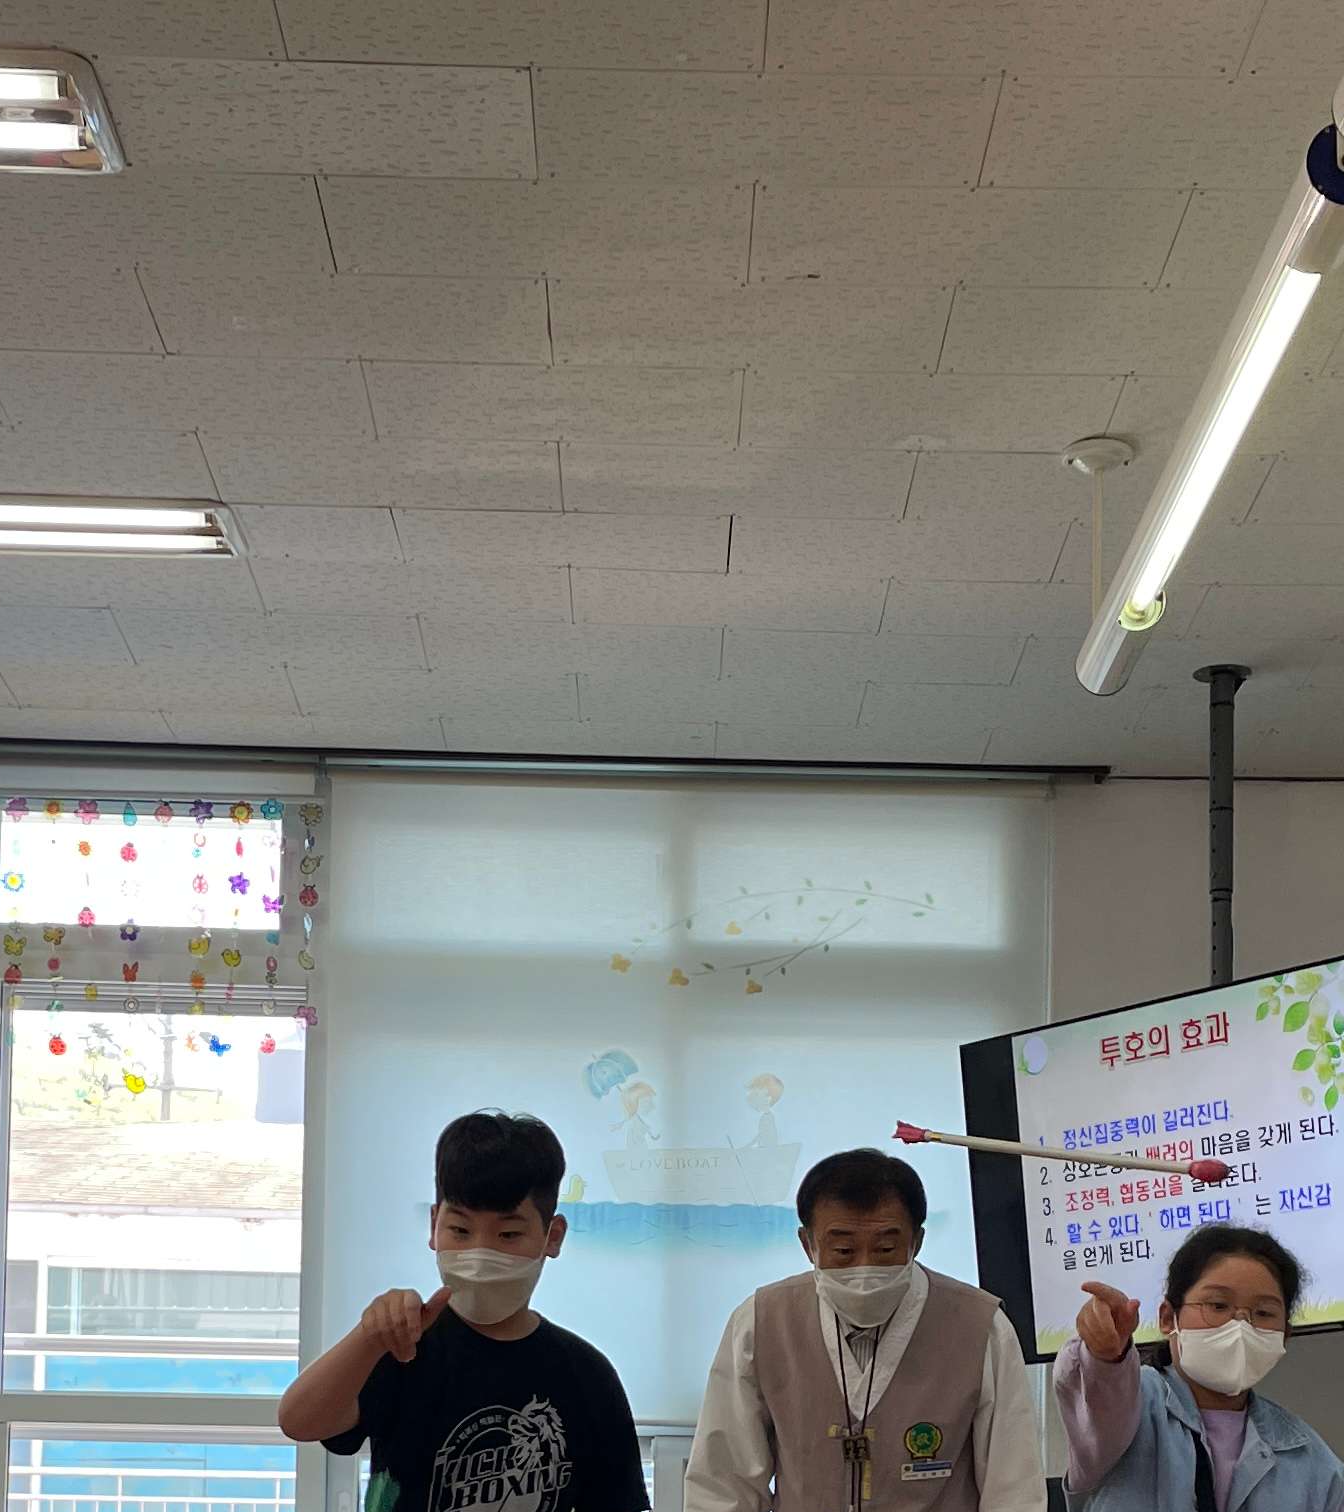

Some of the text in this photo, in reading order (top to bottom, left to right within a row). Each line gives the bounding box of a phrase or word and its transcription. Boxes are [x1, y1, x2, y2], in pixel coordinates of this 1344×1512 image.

[1100, 1011, 1230, 1069] 투호의 효과
[1062, 1114, 1157, 1151] 정신집중력이
[1163, 1099, 1234, 1133] 길러진다.
[1200, 1129, 1251, 1157] 마음을
[1257, 1121, 1293, 1148] 갖게
[1299, 1113, 1340, 1142] 된다.
[1066, 1222, 1083, 1245] 할
[1087, 1219, 1103, 1241] 수
[1255, 1193, 1273, 1216] 는
[1278, 1182, 1333, 1213] 자신감
[1120, 1173, 1184, 1206] 협동심을
[1062, 1238, 1156, 1271] 을 얻게 된다.
